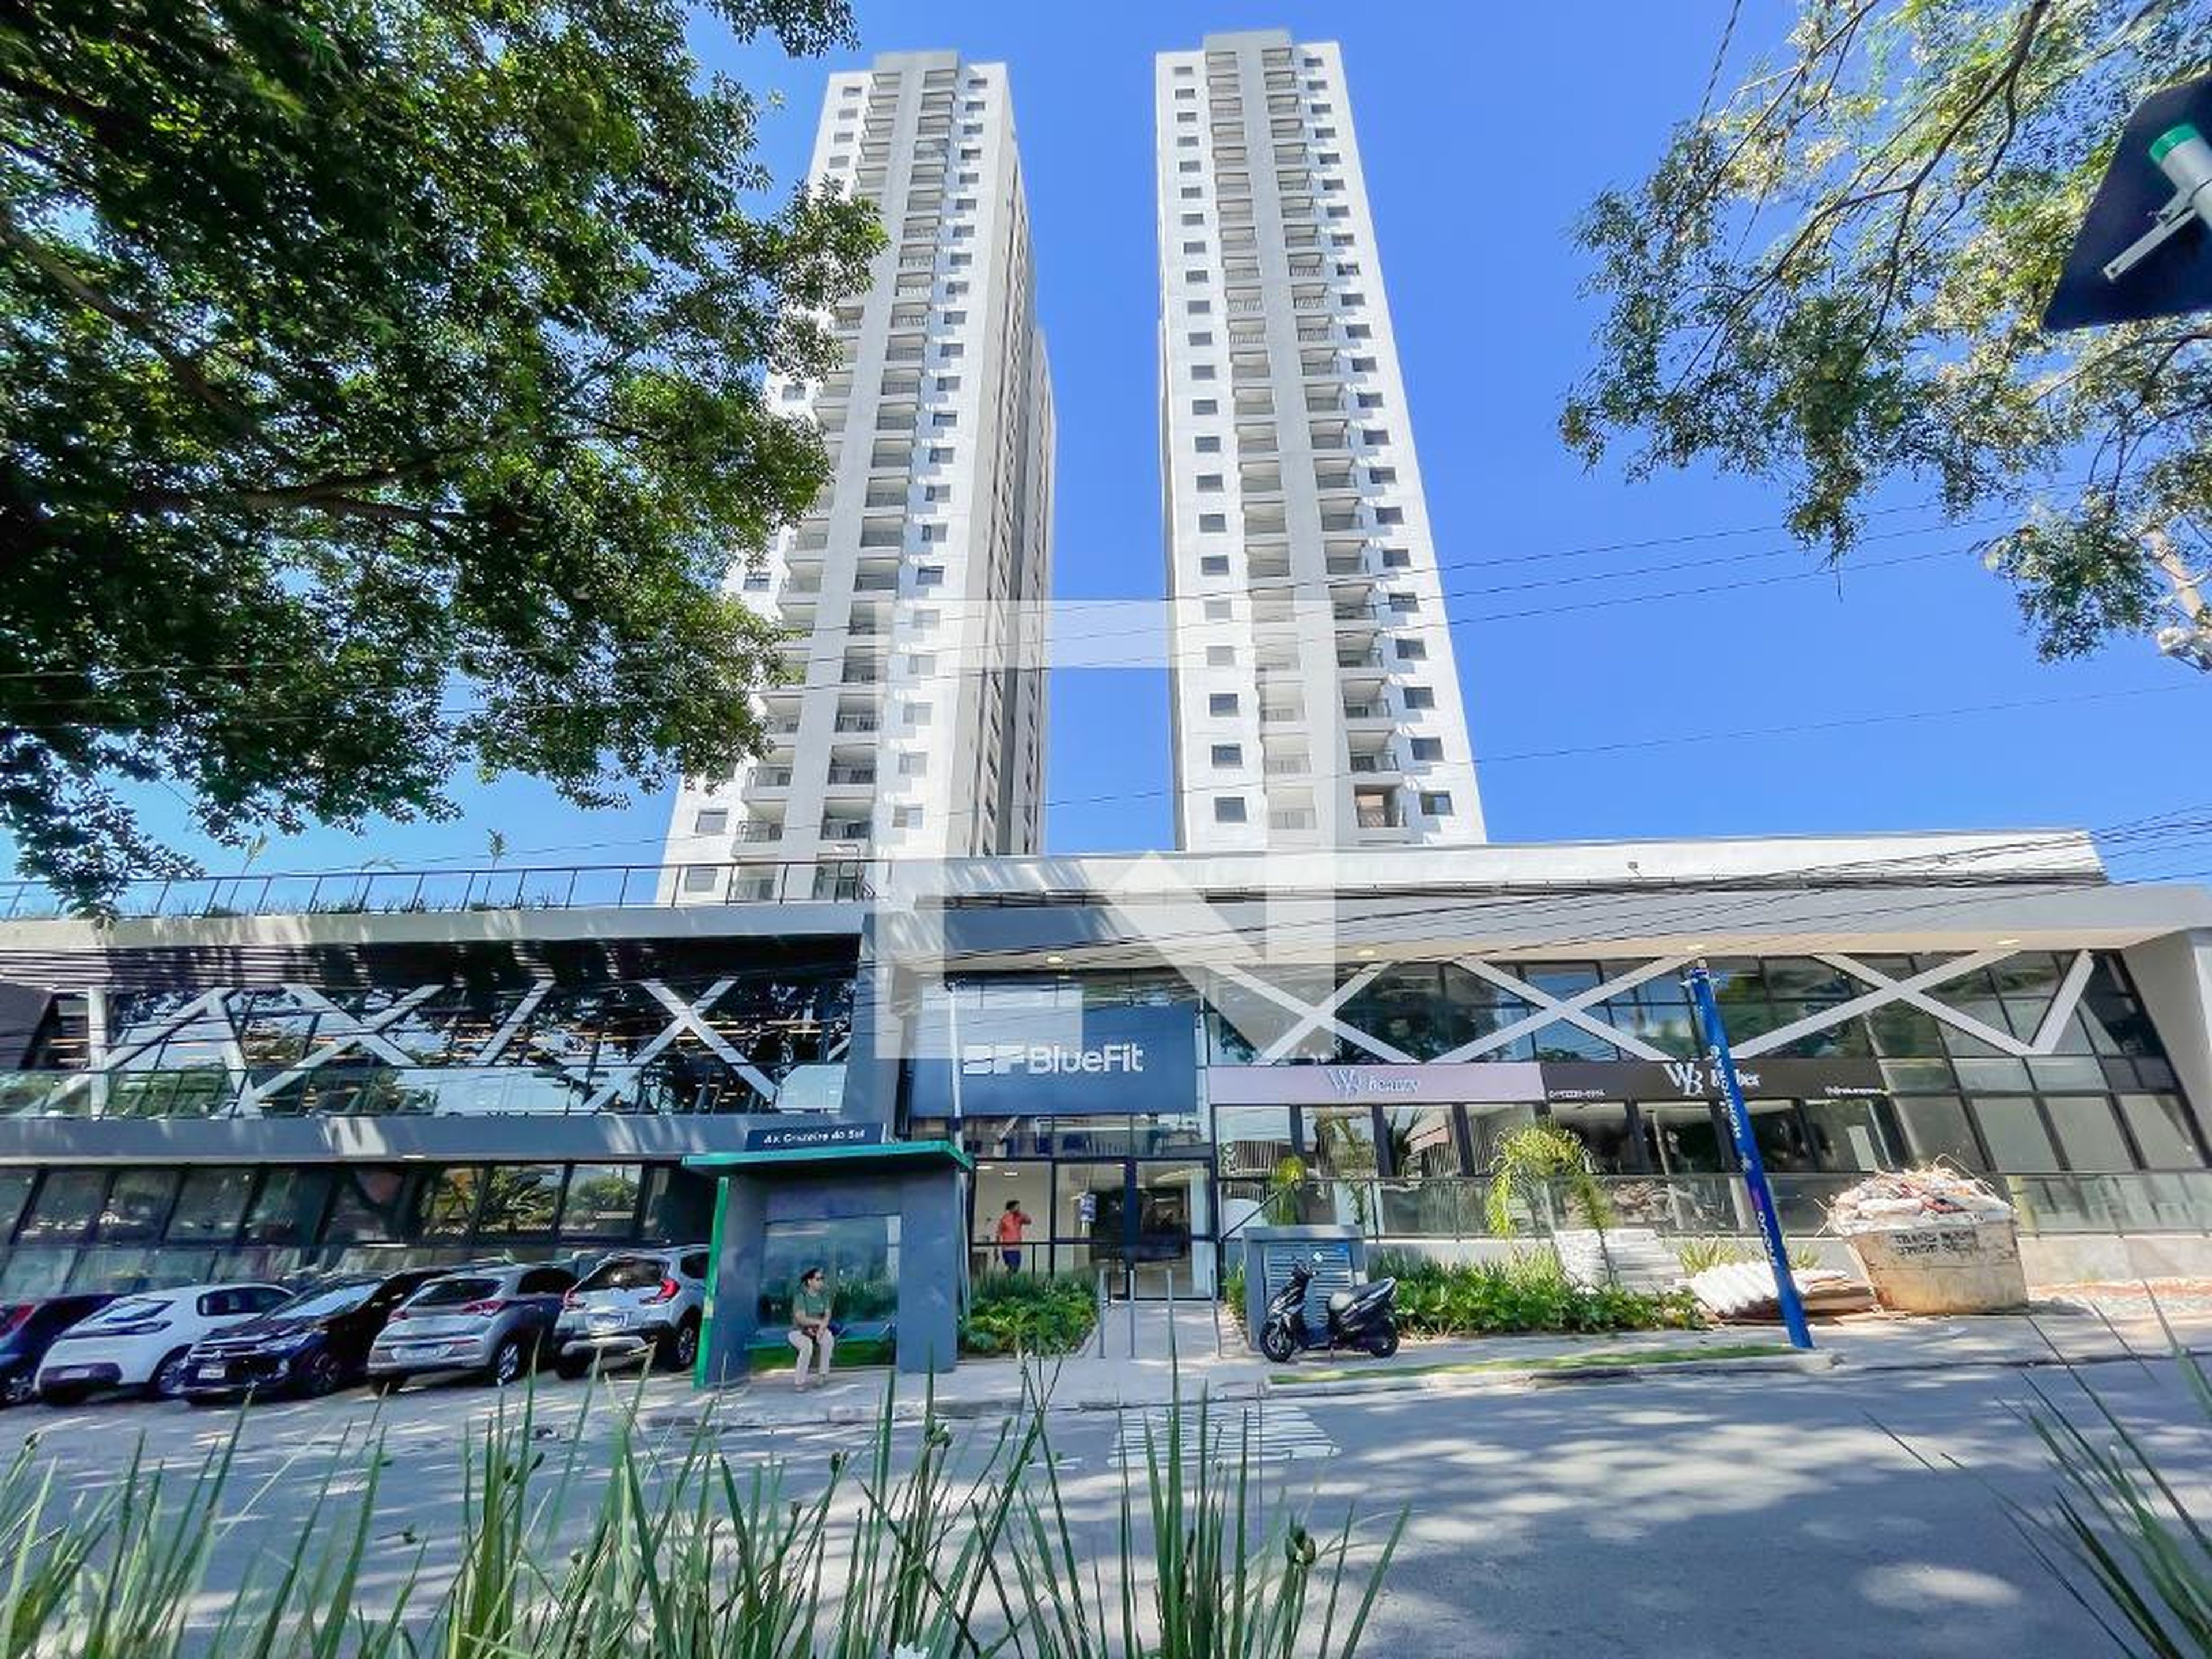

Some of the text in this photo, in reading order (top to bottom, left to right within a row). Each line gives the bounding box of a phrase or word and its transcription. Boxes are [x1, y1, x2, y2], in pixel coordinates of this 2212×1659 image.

[1028, 1043, 1144, 1074] BlueFit
[831, 1130, 846, 1139] do
[848, 1129, 865, 1139] Sul
